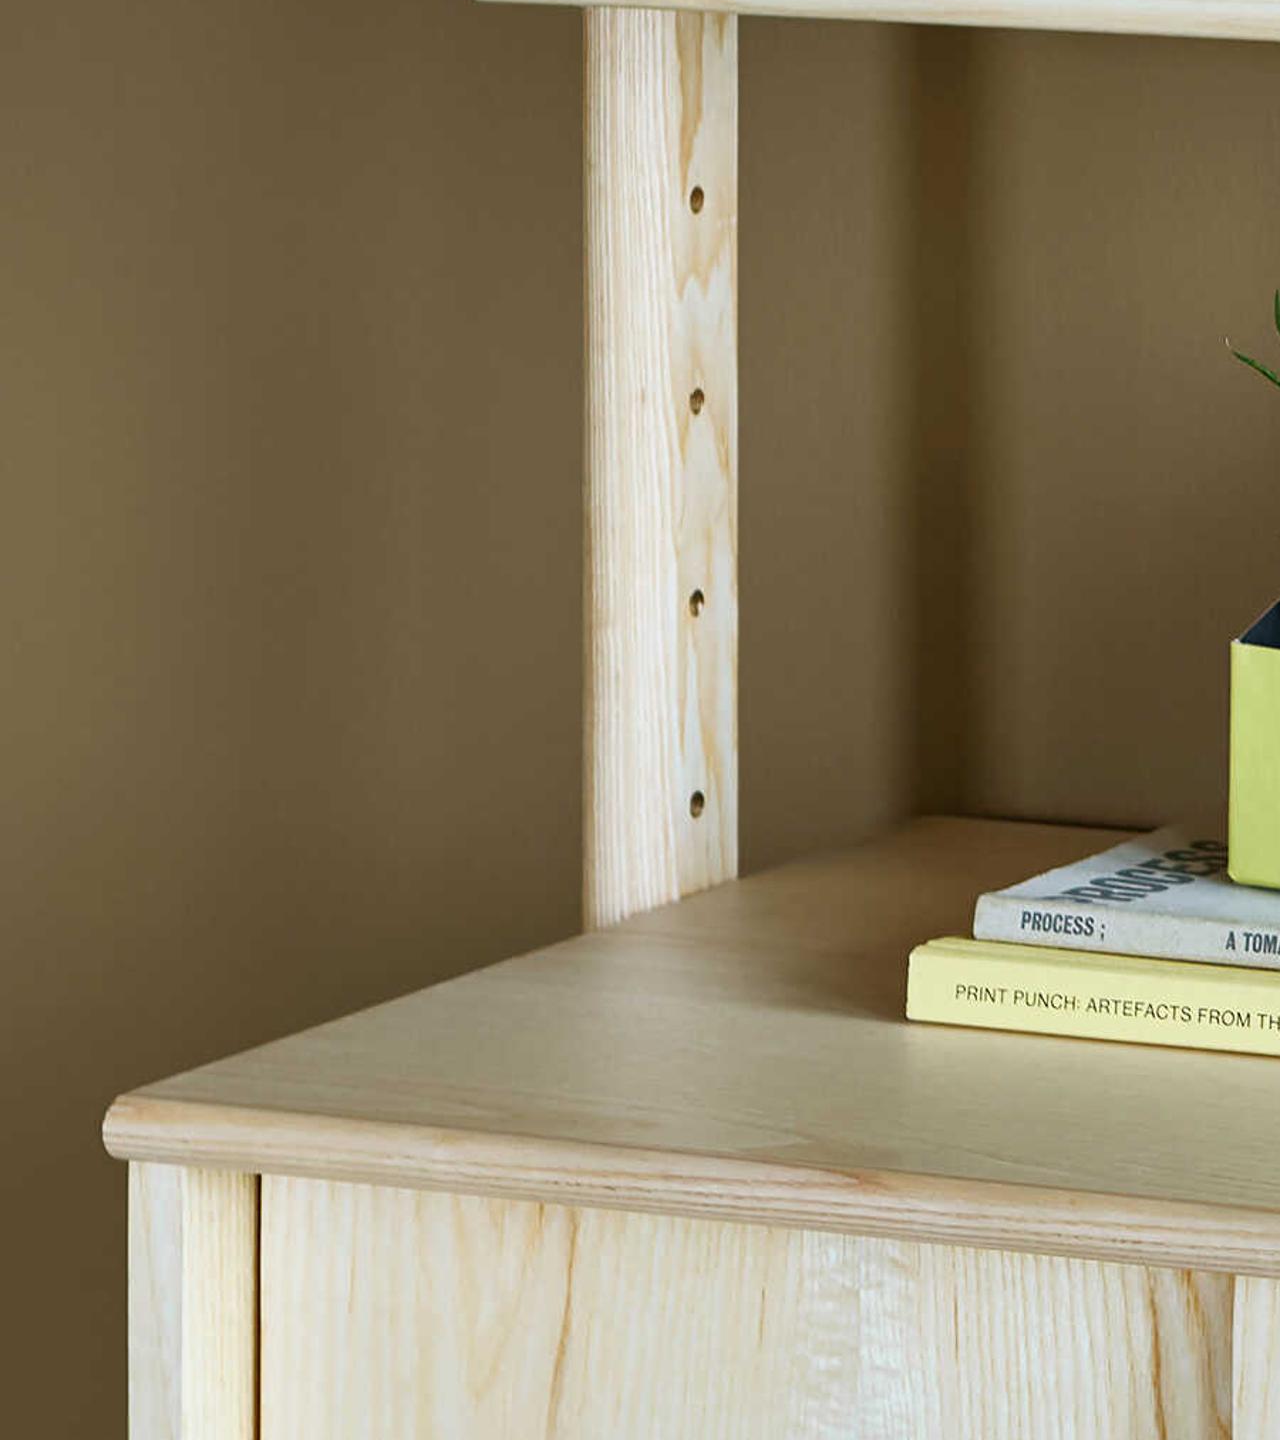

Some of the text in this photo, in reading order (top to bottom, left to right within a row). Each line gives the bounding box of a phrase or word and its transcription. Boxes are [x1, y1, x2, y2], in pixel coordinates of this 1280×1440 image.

[1020, 910, 1095, 937] PROCESS
[1225, 933, 1237, 951] A
[954, 984, 1008, 1004] PRINT
[1013, 989, 1080, 1010] PUNCH:
[1085, 997, 1193, 1022] ARTEFACTS
[1198, 1007, 1251, 1028] FROM
